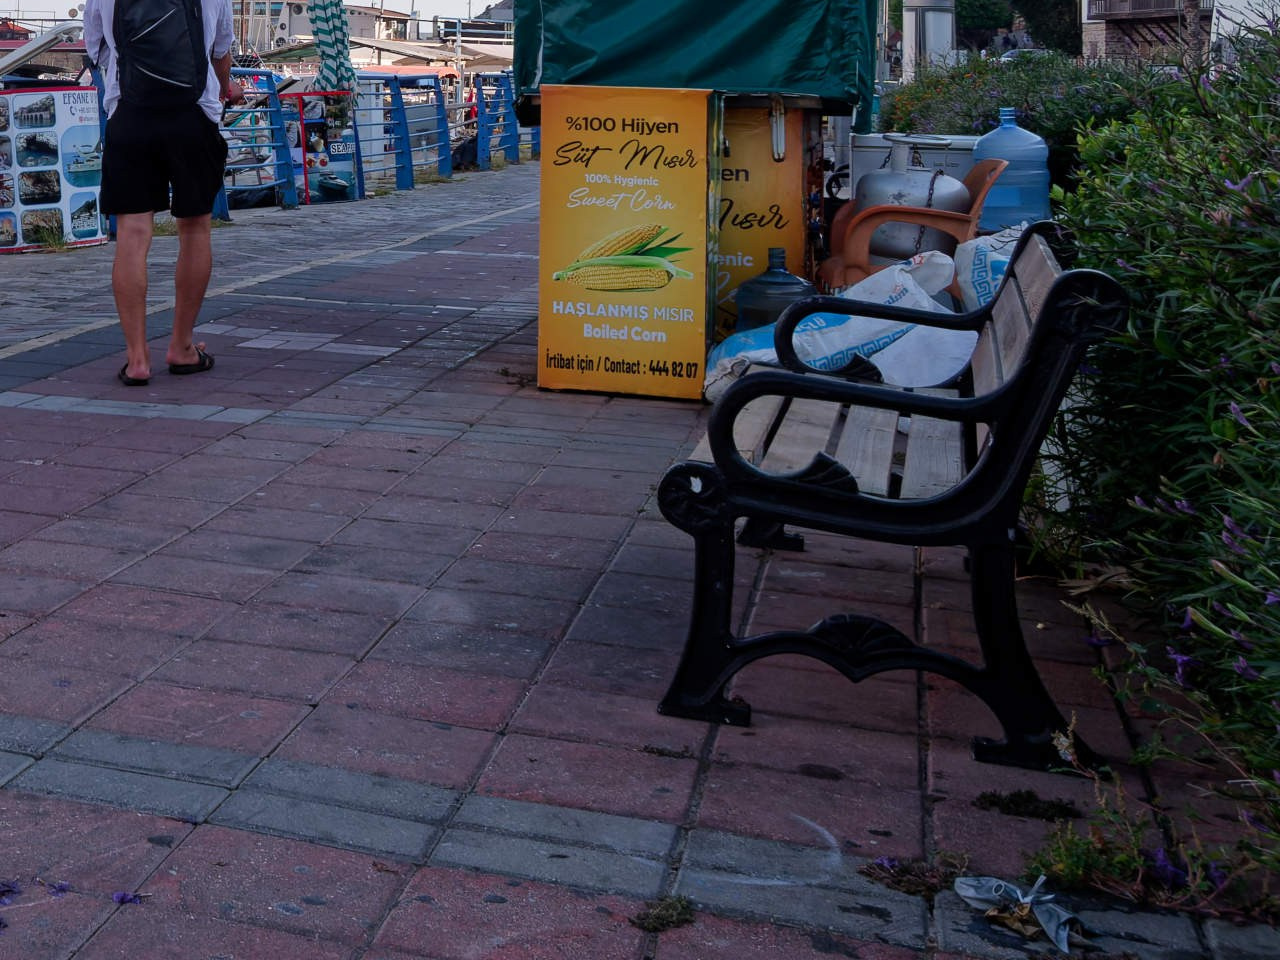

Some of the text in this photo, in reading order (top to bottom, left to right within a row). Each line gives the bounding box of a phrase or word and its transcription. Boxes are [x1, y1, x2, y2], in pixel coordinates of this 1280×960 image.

[565, 116, 679, 136] %100 Hijyen
[552, 140, 613, 168] Süt
[585, 173, 660, 188] 100% Hygienic
[566, 187, 677, 212] Sweet Corn
[552, 301, 695, 322] HAŞLANMIŞ MISIR
[583, 323, 667, 343] Boiled Corn
[546, 348, 575, 370] İrtibat
[577, 354, 594, 375] için
[604, 356, 641, 375] Contact
[649, 359, 669, 377] 444
[671, 361, 684, 378] 82
[686, 362, 699, 379] 07
